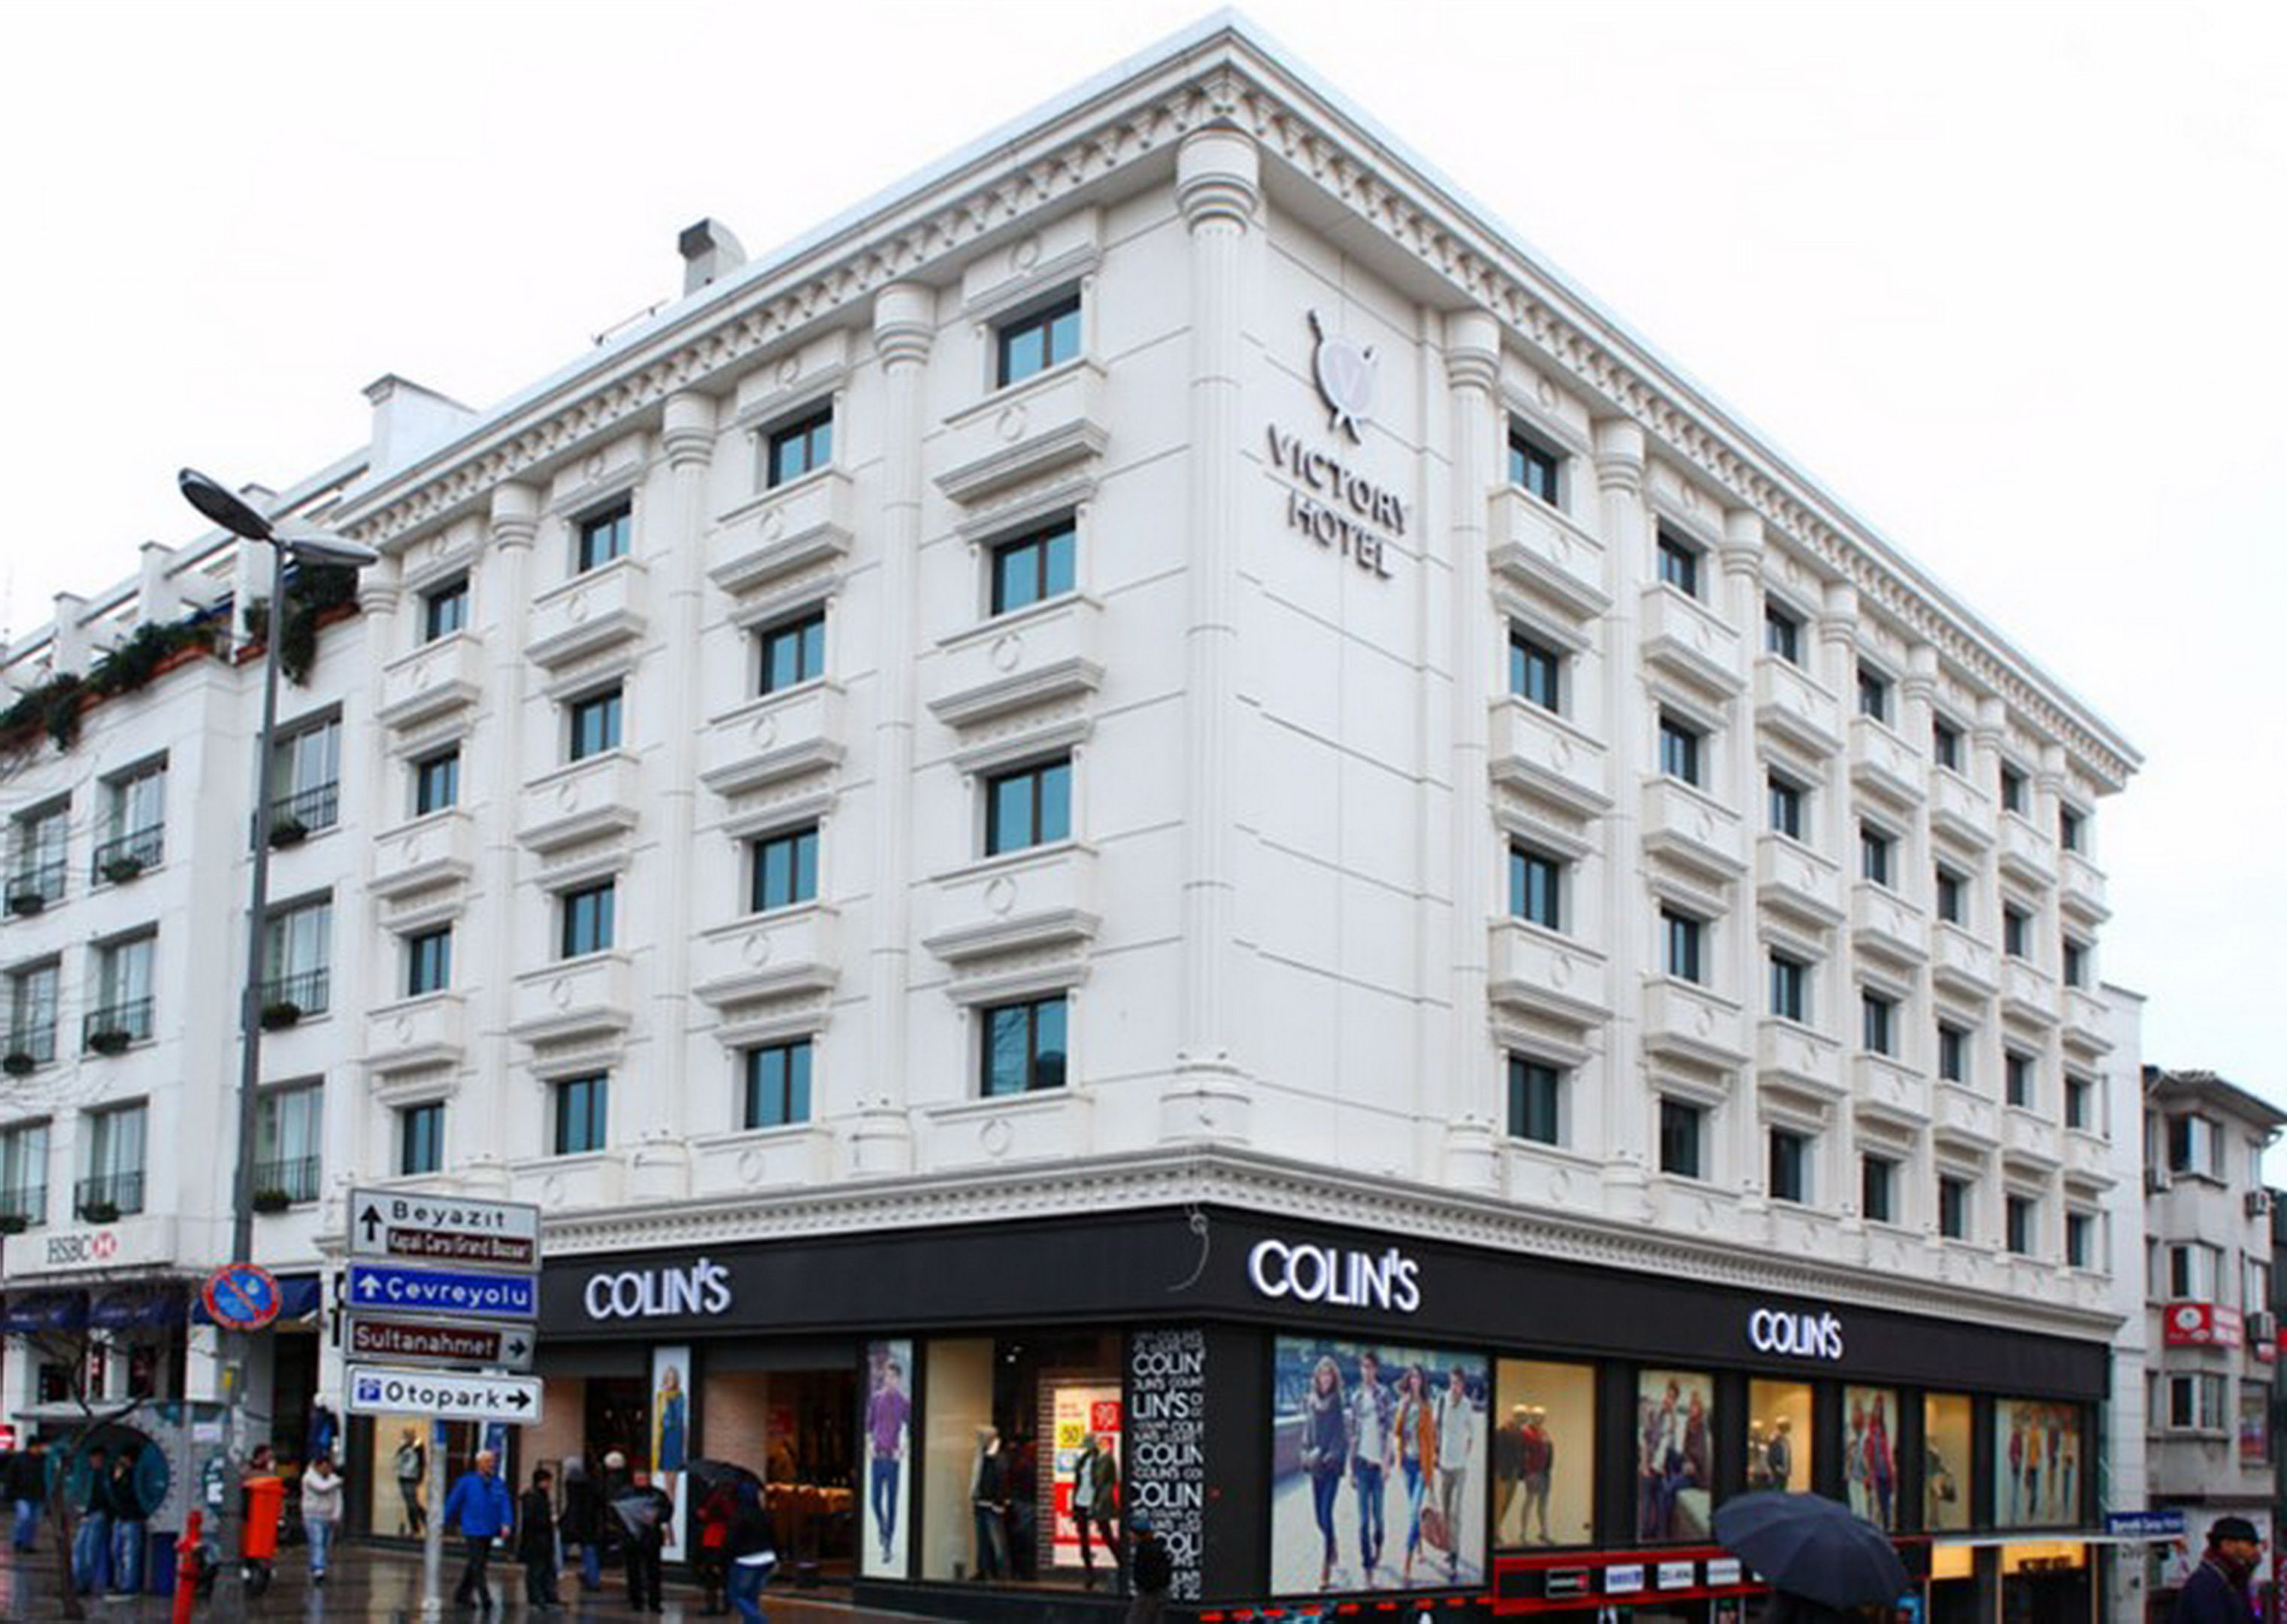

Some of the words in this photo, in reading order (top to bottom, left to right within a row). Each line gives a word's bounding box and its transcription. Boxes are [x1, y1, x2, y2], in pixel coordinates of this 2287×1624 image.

[1268, 423, 1408, 536] VICTORY
[1289, 488, 1394, 580] HOTEL
[47, 1234, 91, 1264] HSBC
[386, 1277, 527, 1307] Çevreyolu
[585, 1257, 731, 1320] COLIN'S
[1249, 1240, 1419, 1311] COLIN'S
[356, 1326, 494, 1355] Sultanahmet
[1749, 1308, 1843, 1359] COLIN'S
[386, 1381, 501, 1409] Otopark
[1132, 1388, 1189, 1419] LIN'S
